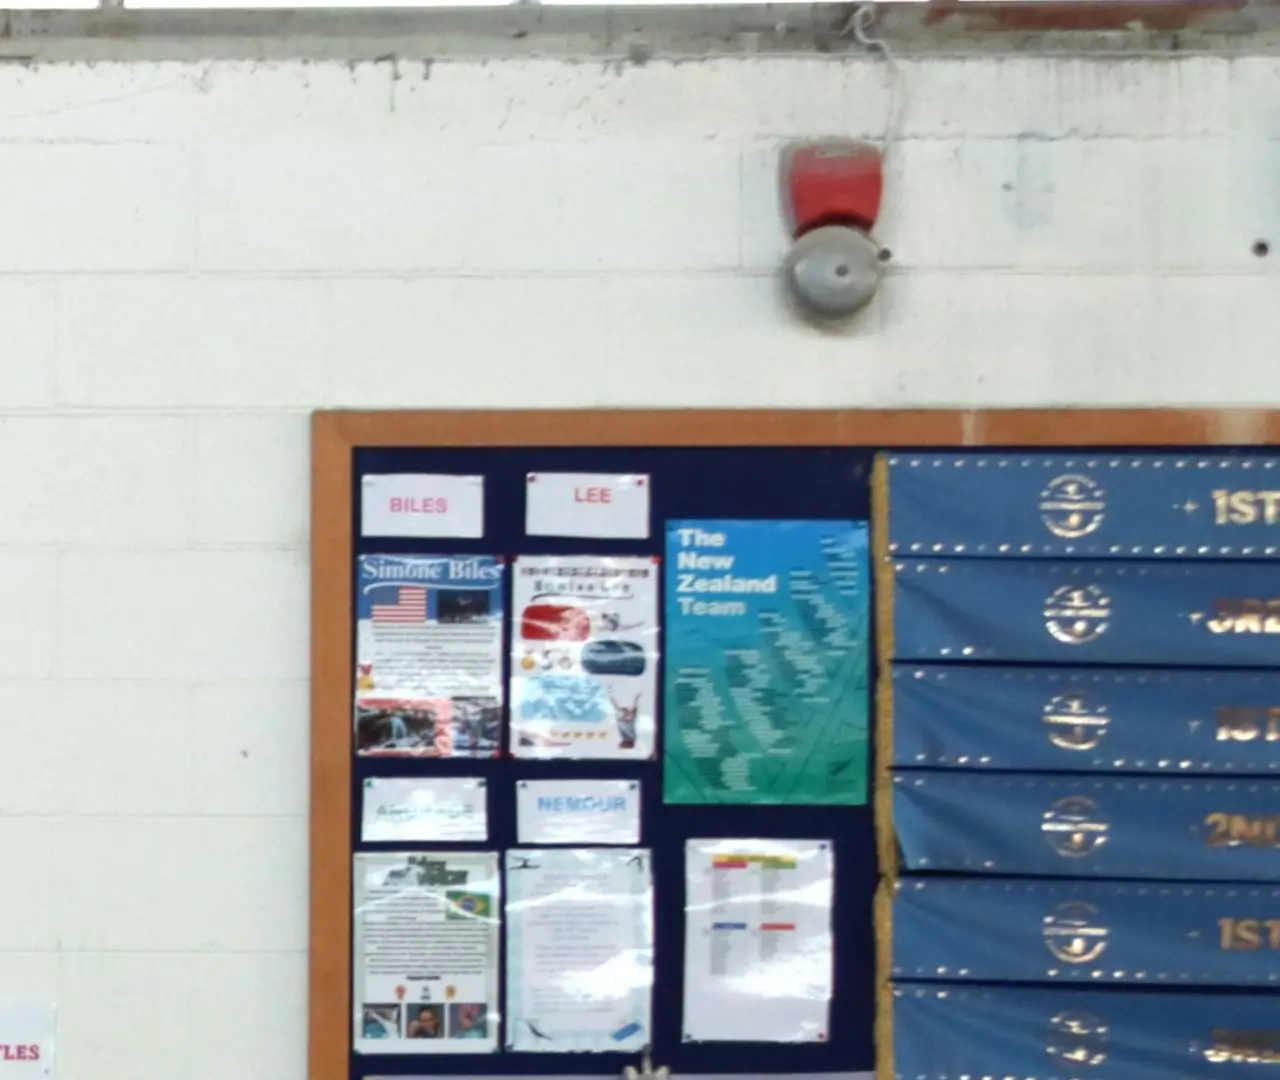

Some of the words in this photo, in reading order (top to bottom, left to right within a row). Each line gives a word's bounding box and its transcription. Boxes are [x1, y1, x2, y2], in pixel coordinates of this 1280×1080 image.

[574, 487, 612, 504] LEE
[390, 497, 448, 515] BILES
[676, 528, 727, 547] The
[361, 560, 443, 580] Simone
[447, 559, 502, 580] Biles
[676, 551, 736, 570] New
[676, 573, 778, 593] Zealand
[676, 596, 747, 616] Team
